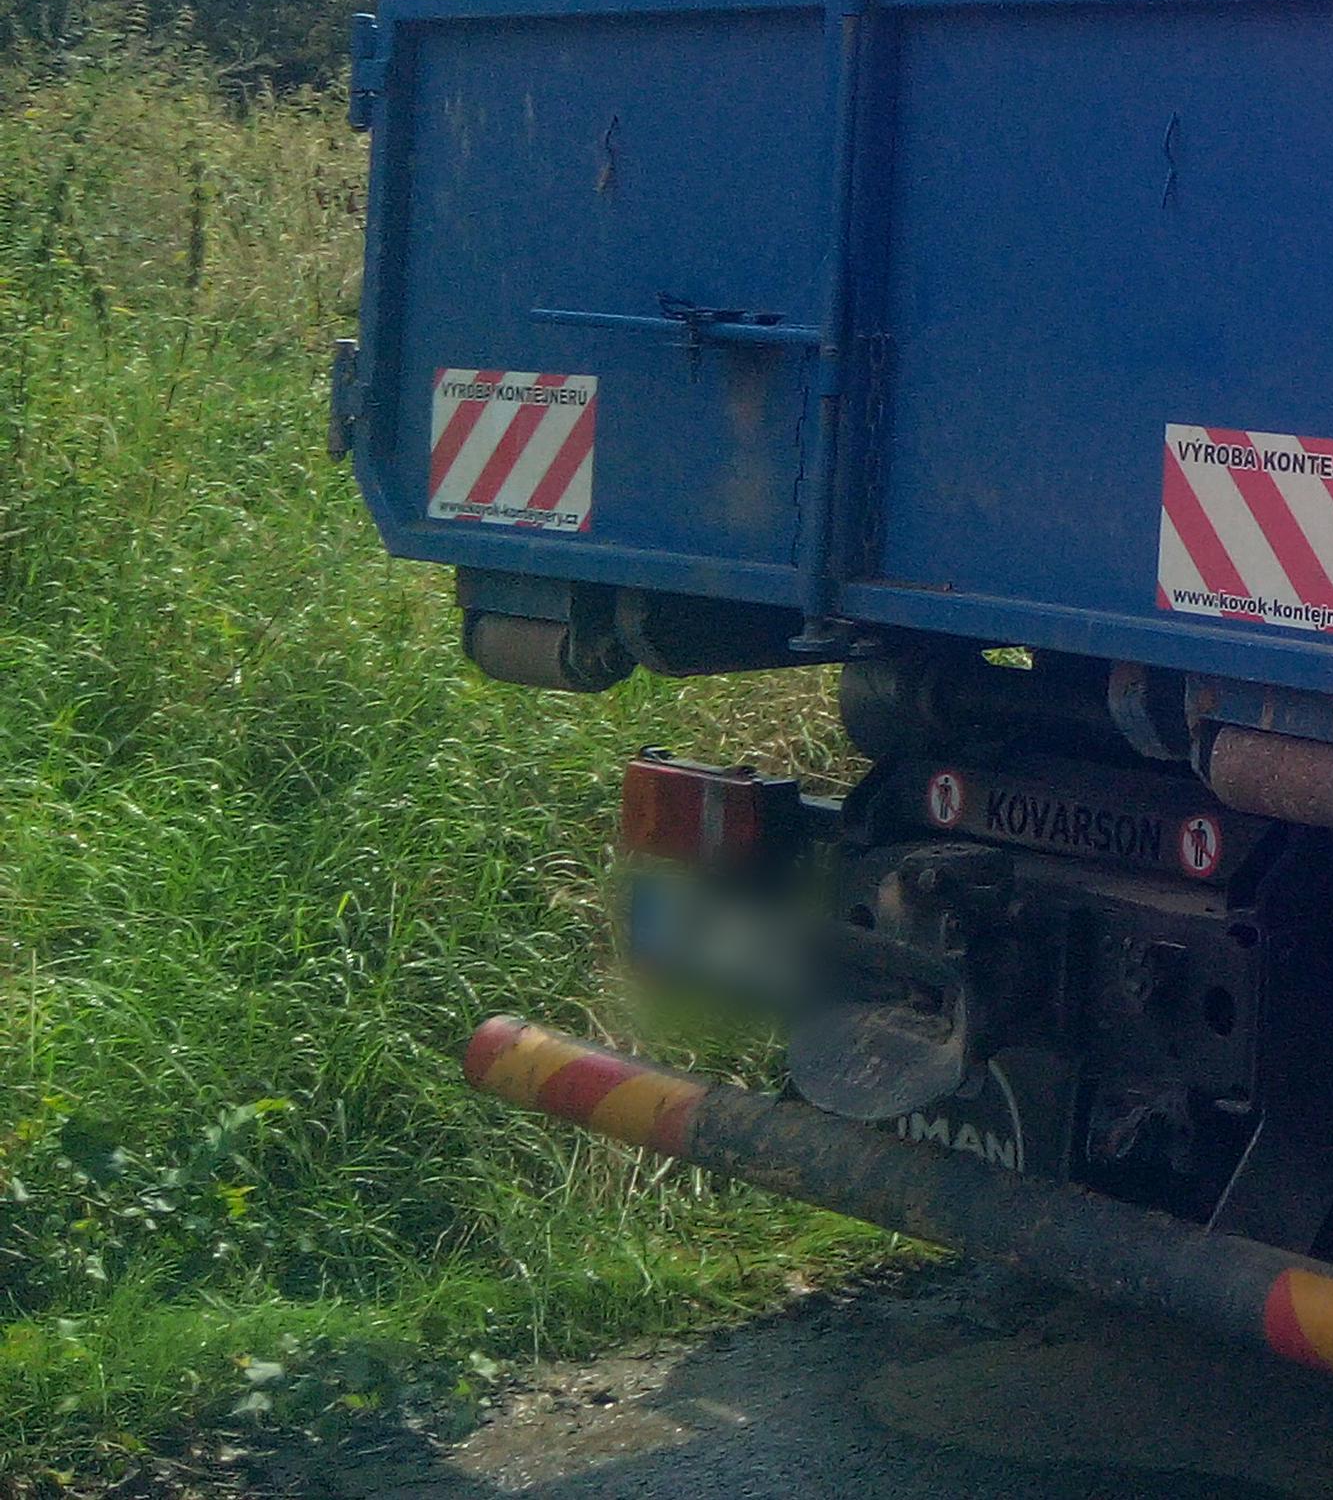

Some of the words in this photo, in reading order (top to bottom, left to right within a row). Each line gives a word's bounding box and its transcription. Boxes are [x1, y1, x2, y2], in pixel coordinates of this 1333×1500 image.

[1178, 439, 1257, 468] VÝROBA
[987, 790, 1162, 861] KOVARSON
[911, 1112, 1018, 1172] MAN
